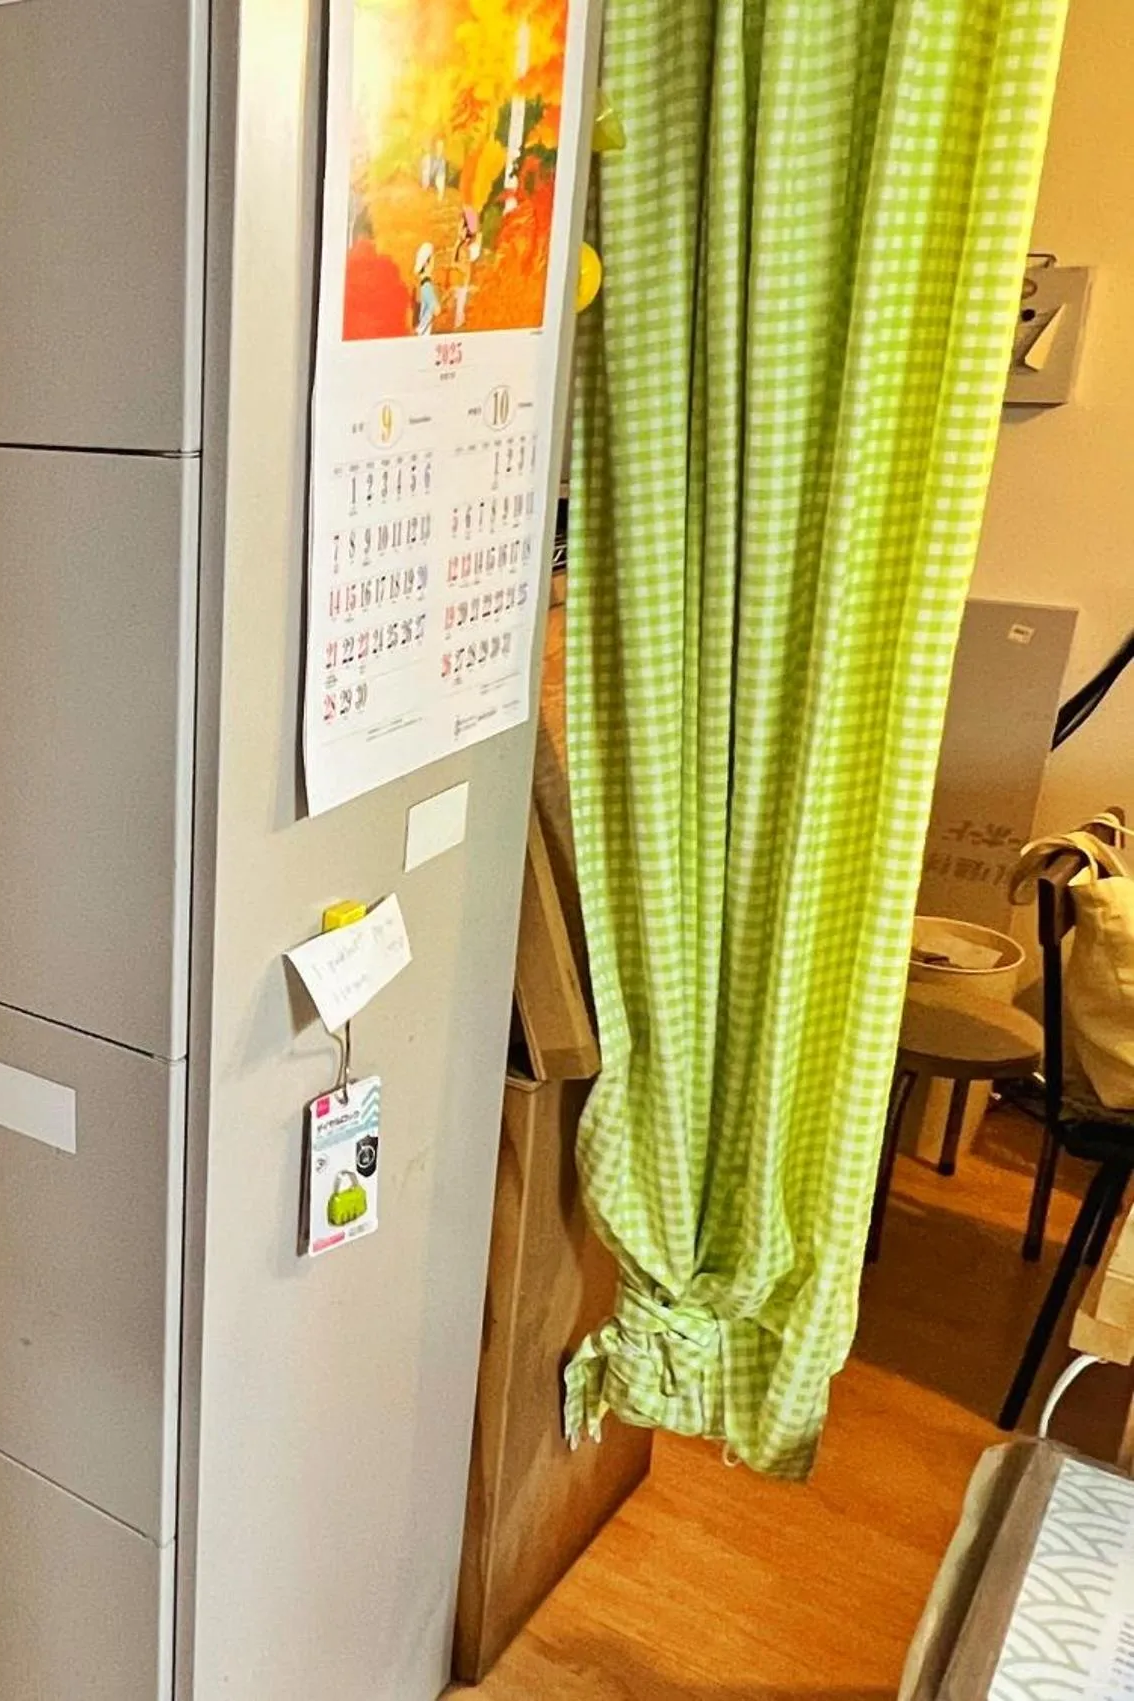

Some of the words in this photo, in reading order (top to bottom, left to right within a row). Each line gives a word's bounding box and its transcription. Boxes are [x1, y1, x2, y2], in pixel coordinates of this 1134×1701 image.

[381, 404, 392, 443] 9
[493, 389, 509, 425] 10
[392, 521, 402, 547] 11
